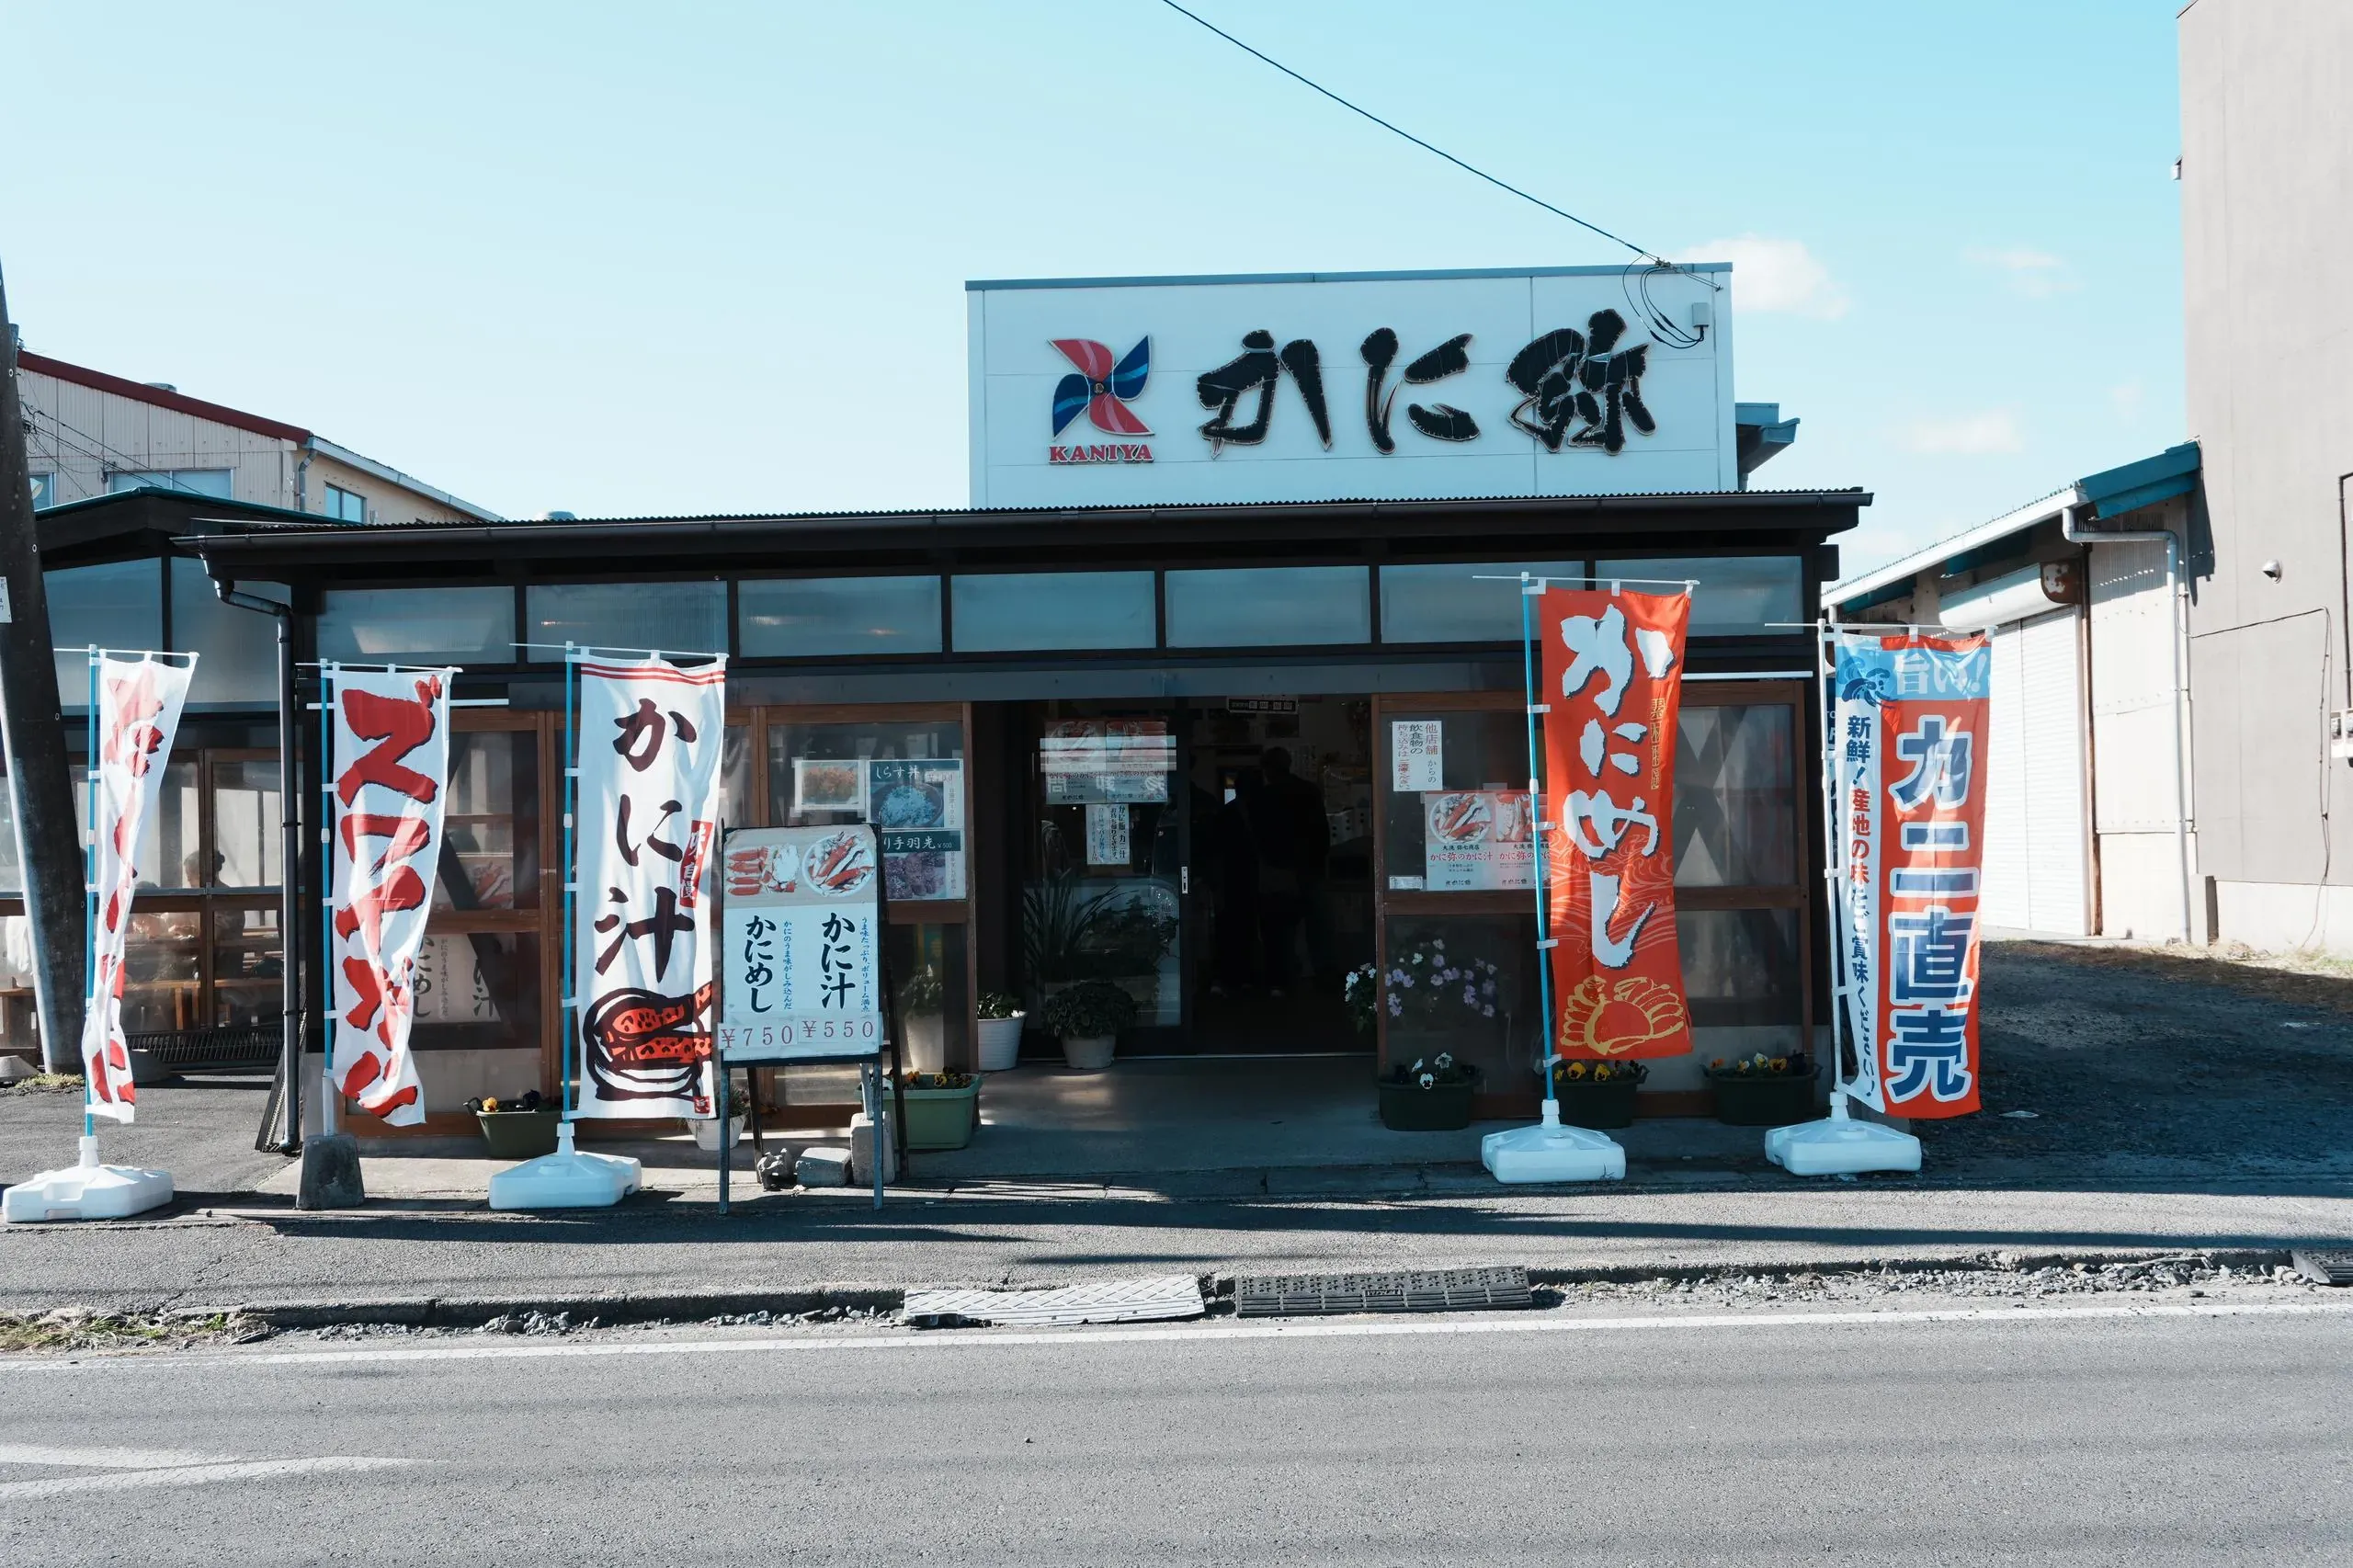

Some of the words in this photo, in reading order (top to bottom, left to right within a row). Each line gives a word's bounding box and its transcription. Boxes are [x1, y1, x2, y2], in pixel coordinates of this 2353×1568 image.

[1049, 444, 1154, 462] KANIYA
[875, 764, 920, 780] しらす丼
[1409, 723, 1423, 756] 飲食物の
[1561, 604, 1675, 969] かにめし
[594, 698, 697, 983] かに汁
[679, 823, 706, 901] 味自慢
[1429, 851, 1494, 862] かに弥のかに汁
[1887, 714, 1980, 1103] カニ直売
[745, 915, 777, 1013] かにめし
[782, 920, 792, 1010] かにのうま味がしみ込んだ
[820, 912, 856, 1009] かに汁
[859, 916, 871, 1013] うま味たっぷり、ボリューム満点
[721, 1025, 793, 1049] ¥750
[802, 1020, 874, 1039] ¥550
